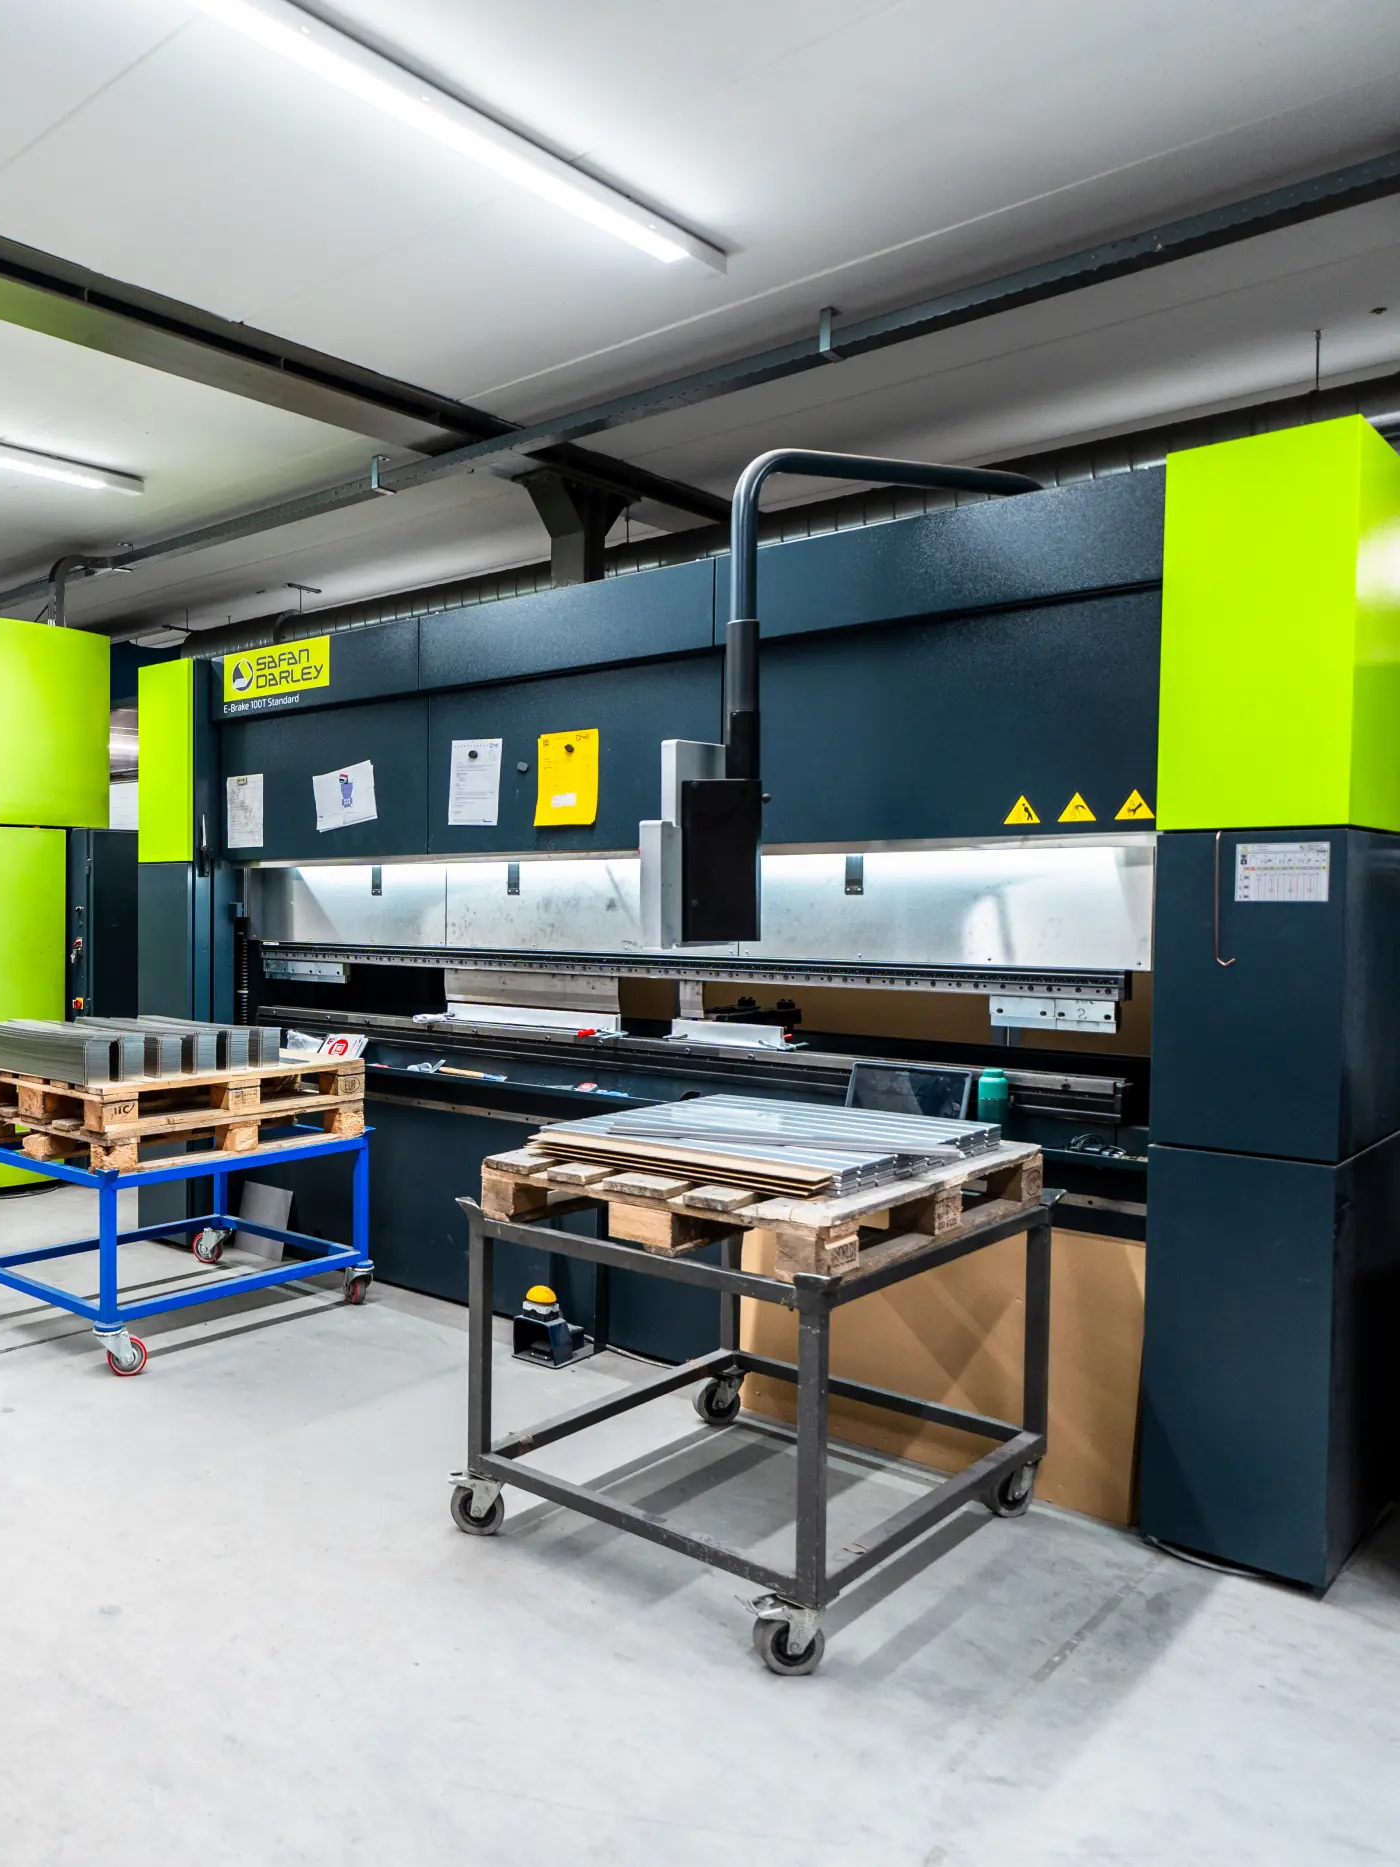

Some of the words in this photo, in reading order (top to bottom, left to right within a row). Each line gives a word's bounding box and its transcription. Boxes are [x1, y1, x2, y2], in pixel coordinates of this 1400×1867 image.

[223, 702, 250, 714] E-Brake
[251, 698, 267, 710] 100T
[267, 694, 300, 707] Standard
